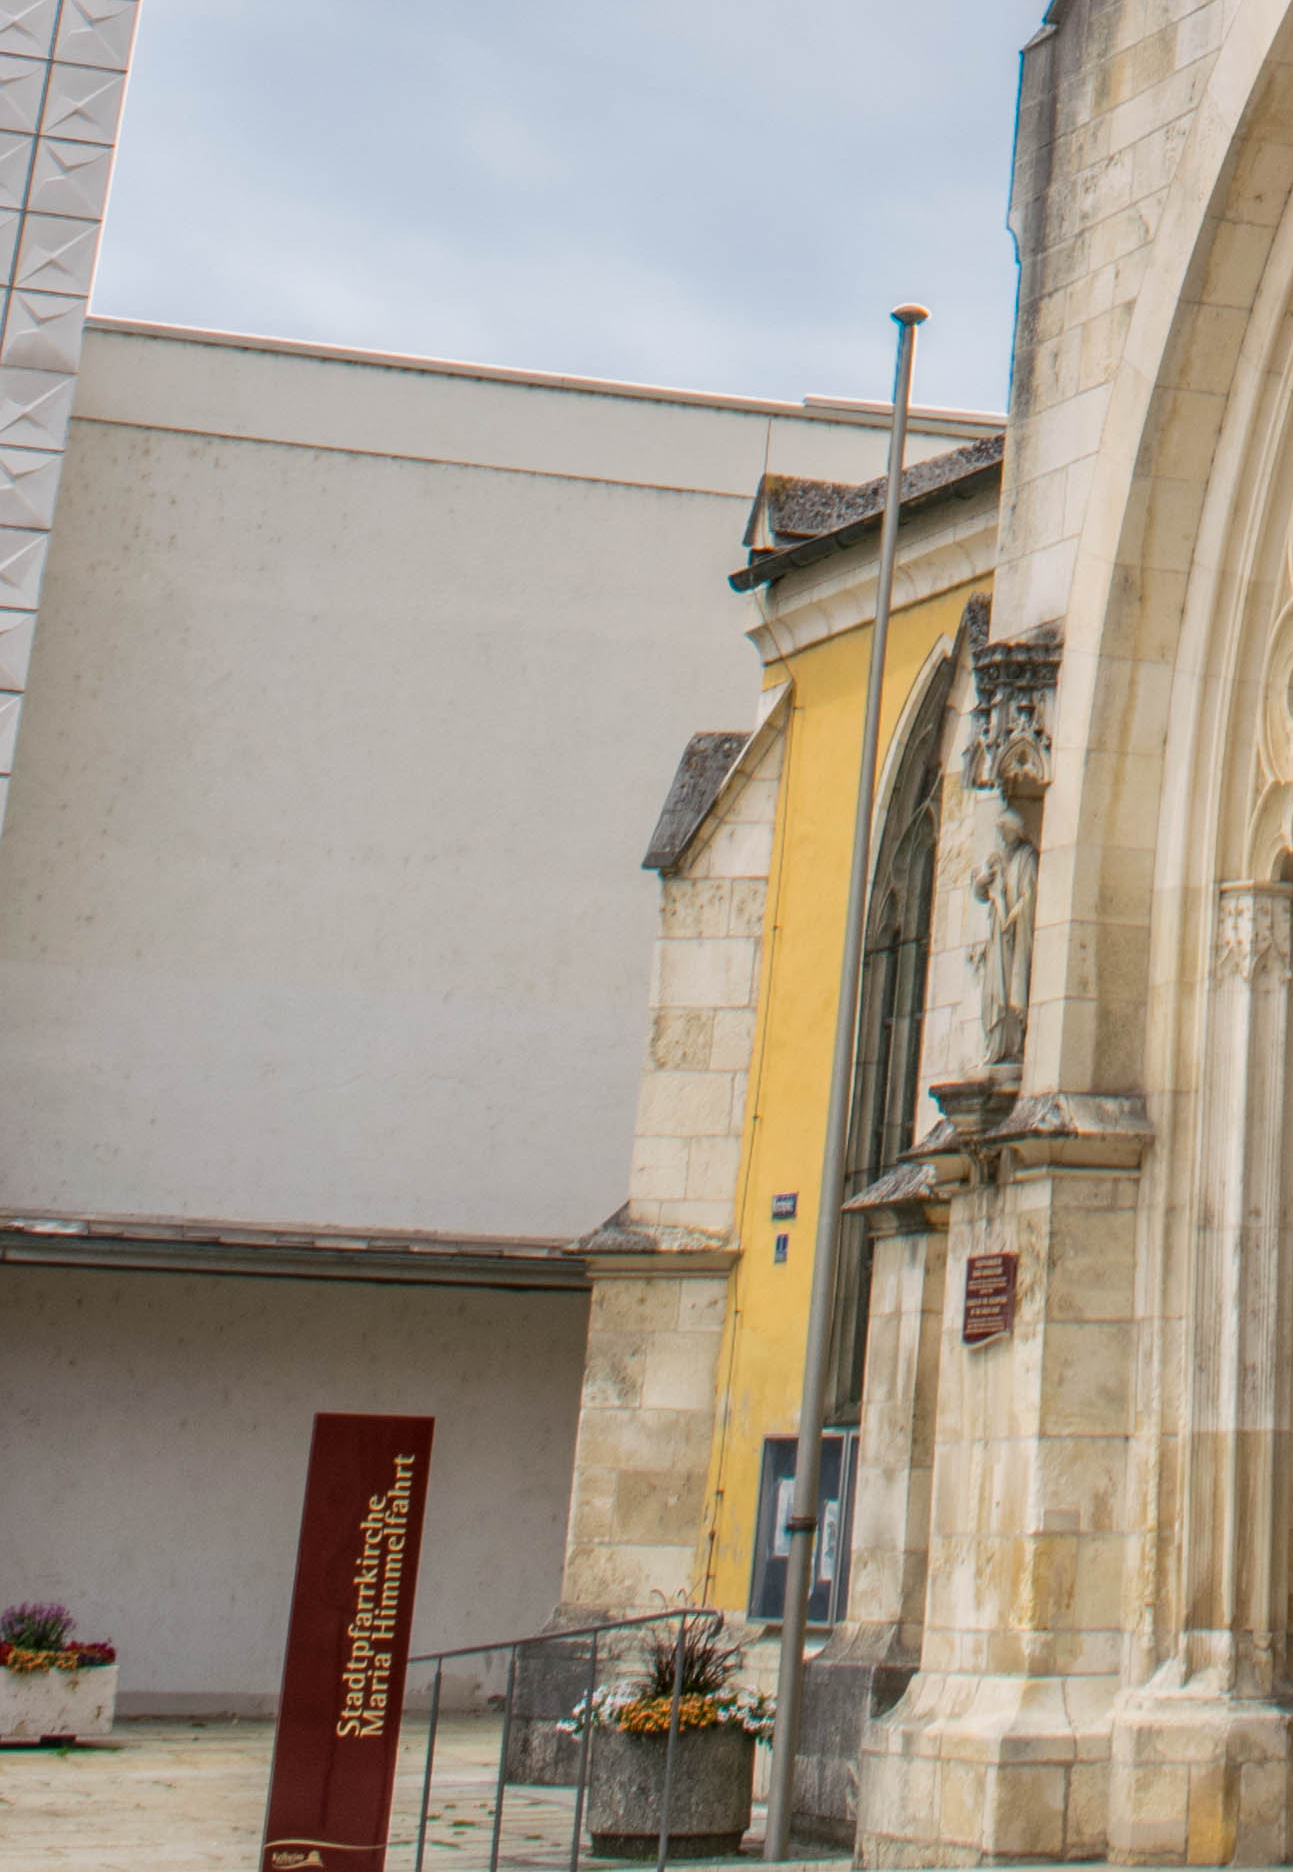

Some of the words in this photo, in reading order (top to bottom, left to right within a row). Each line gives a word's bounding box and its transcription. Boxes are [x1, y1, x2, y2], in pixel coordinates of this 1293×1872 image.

[336, 1494, 387, 1738] Stadtpfarrkirche
[371, 1454, 416, 1641] Himmelfahrt
[360, 1652, 393, 1738] Maria
